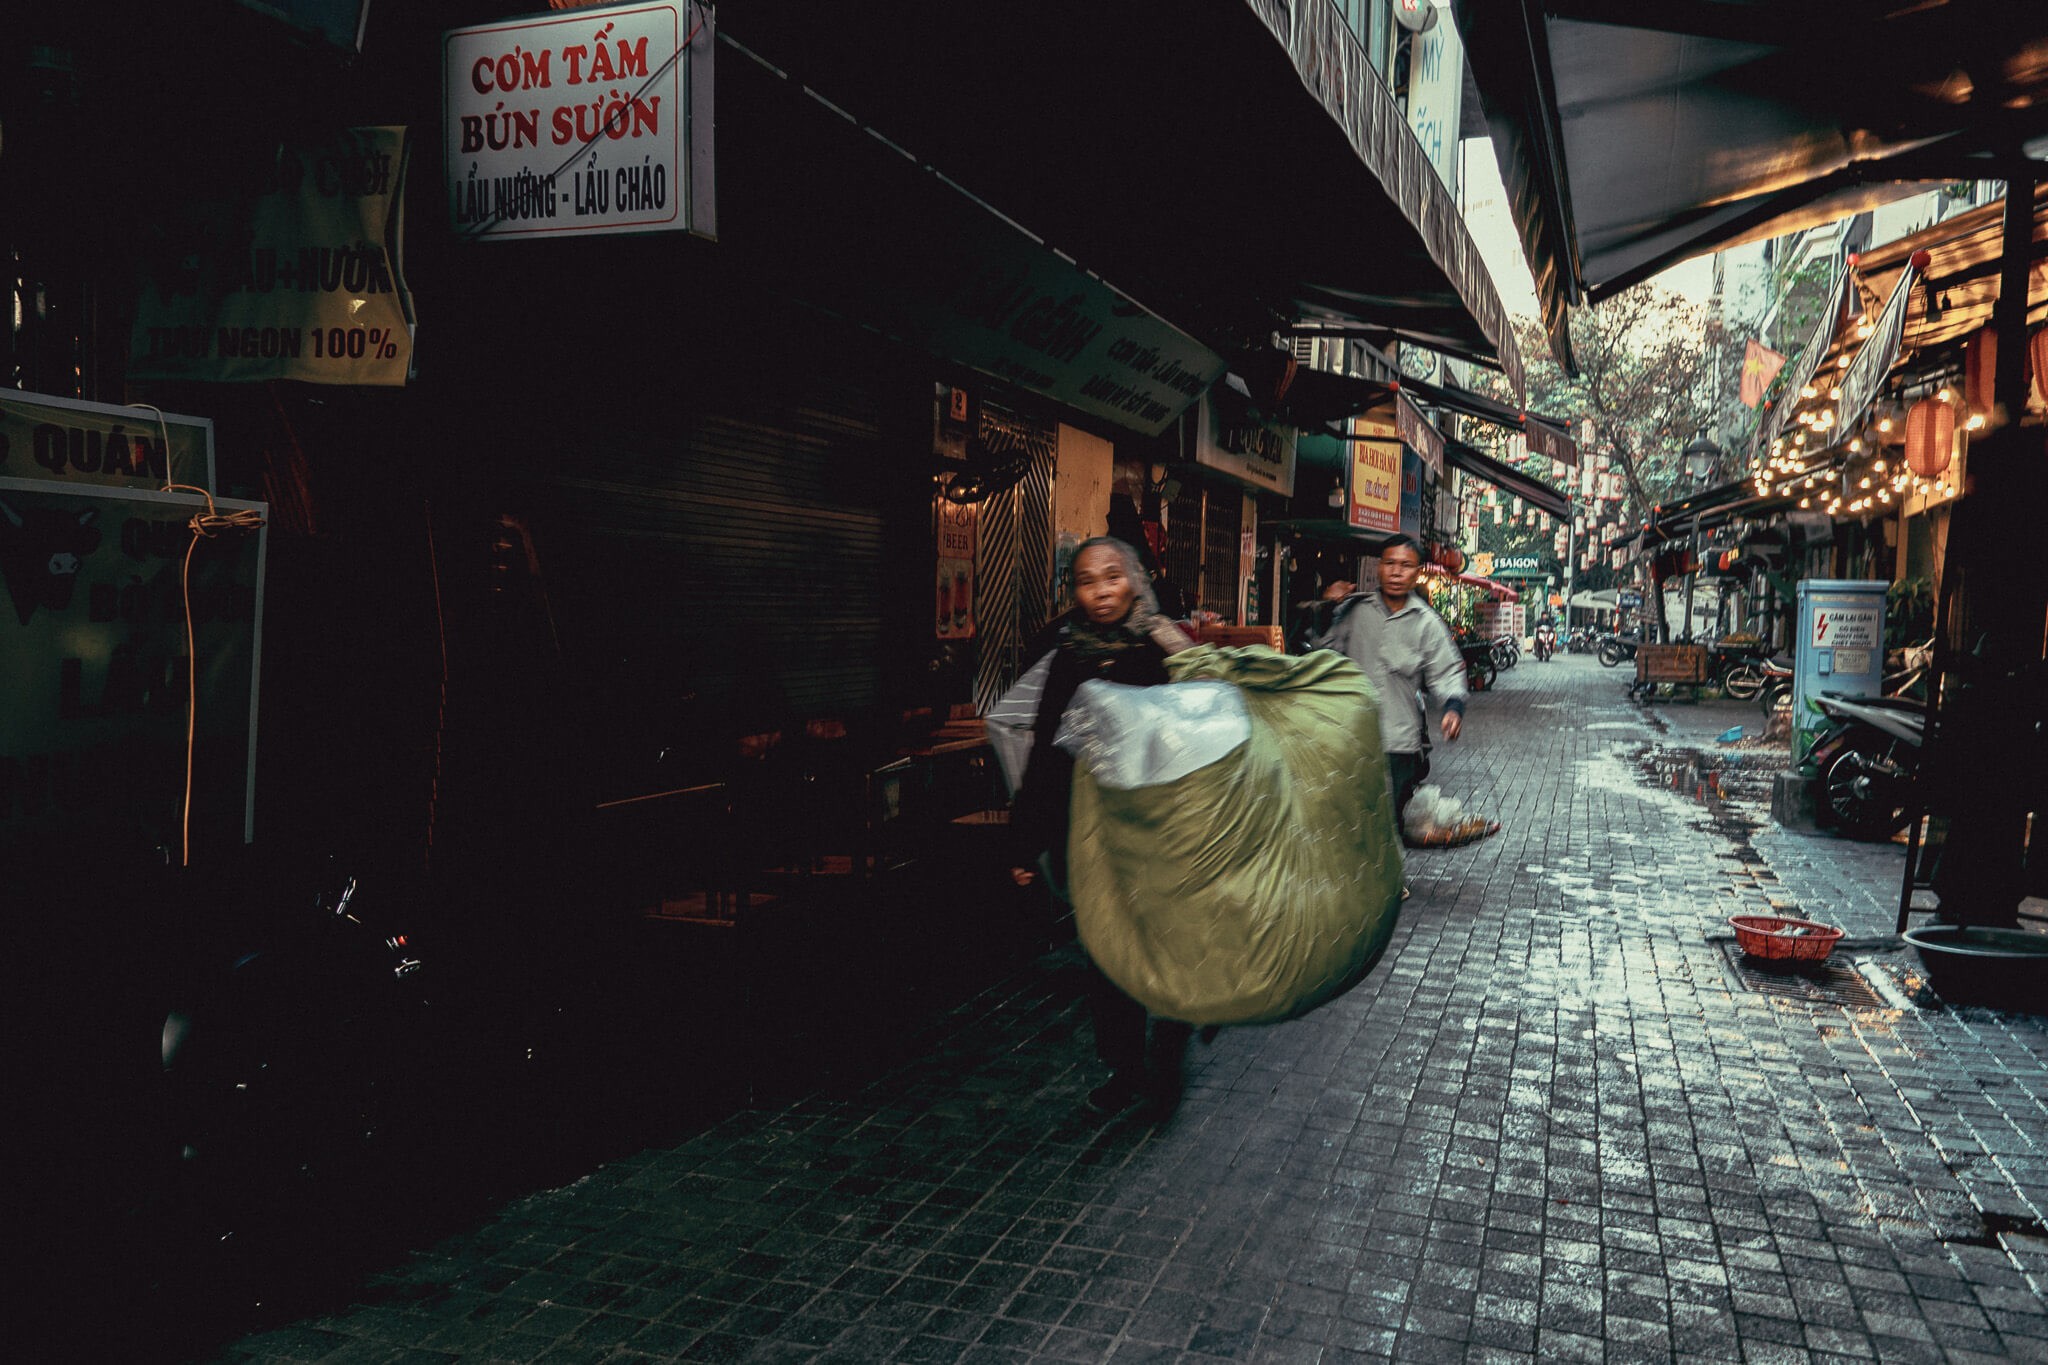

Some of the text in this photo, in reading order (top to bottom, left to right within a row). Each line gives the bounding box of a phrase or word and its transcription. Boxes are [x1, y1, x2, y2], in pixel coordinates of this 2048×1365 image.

[472, 22, 649, 95] CƠM TẤM
[461, 89, 661, 154] BÚN SƯỜN
[457, 161, 492, 225] LẨU
[494, 167, 556, 220] NƯỚNG
[575, 151, 609, 215] LẨU
[615, 155, 666, 212] CHÁO
[218, 326, 301, 358] NGON
[311, 328, 397, 359] 100%
[33, 423, 169, 480] QUÁN
[946, 533, 969, 551] BEER
[1500, 557, 1538, 569] SAIGON
